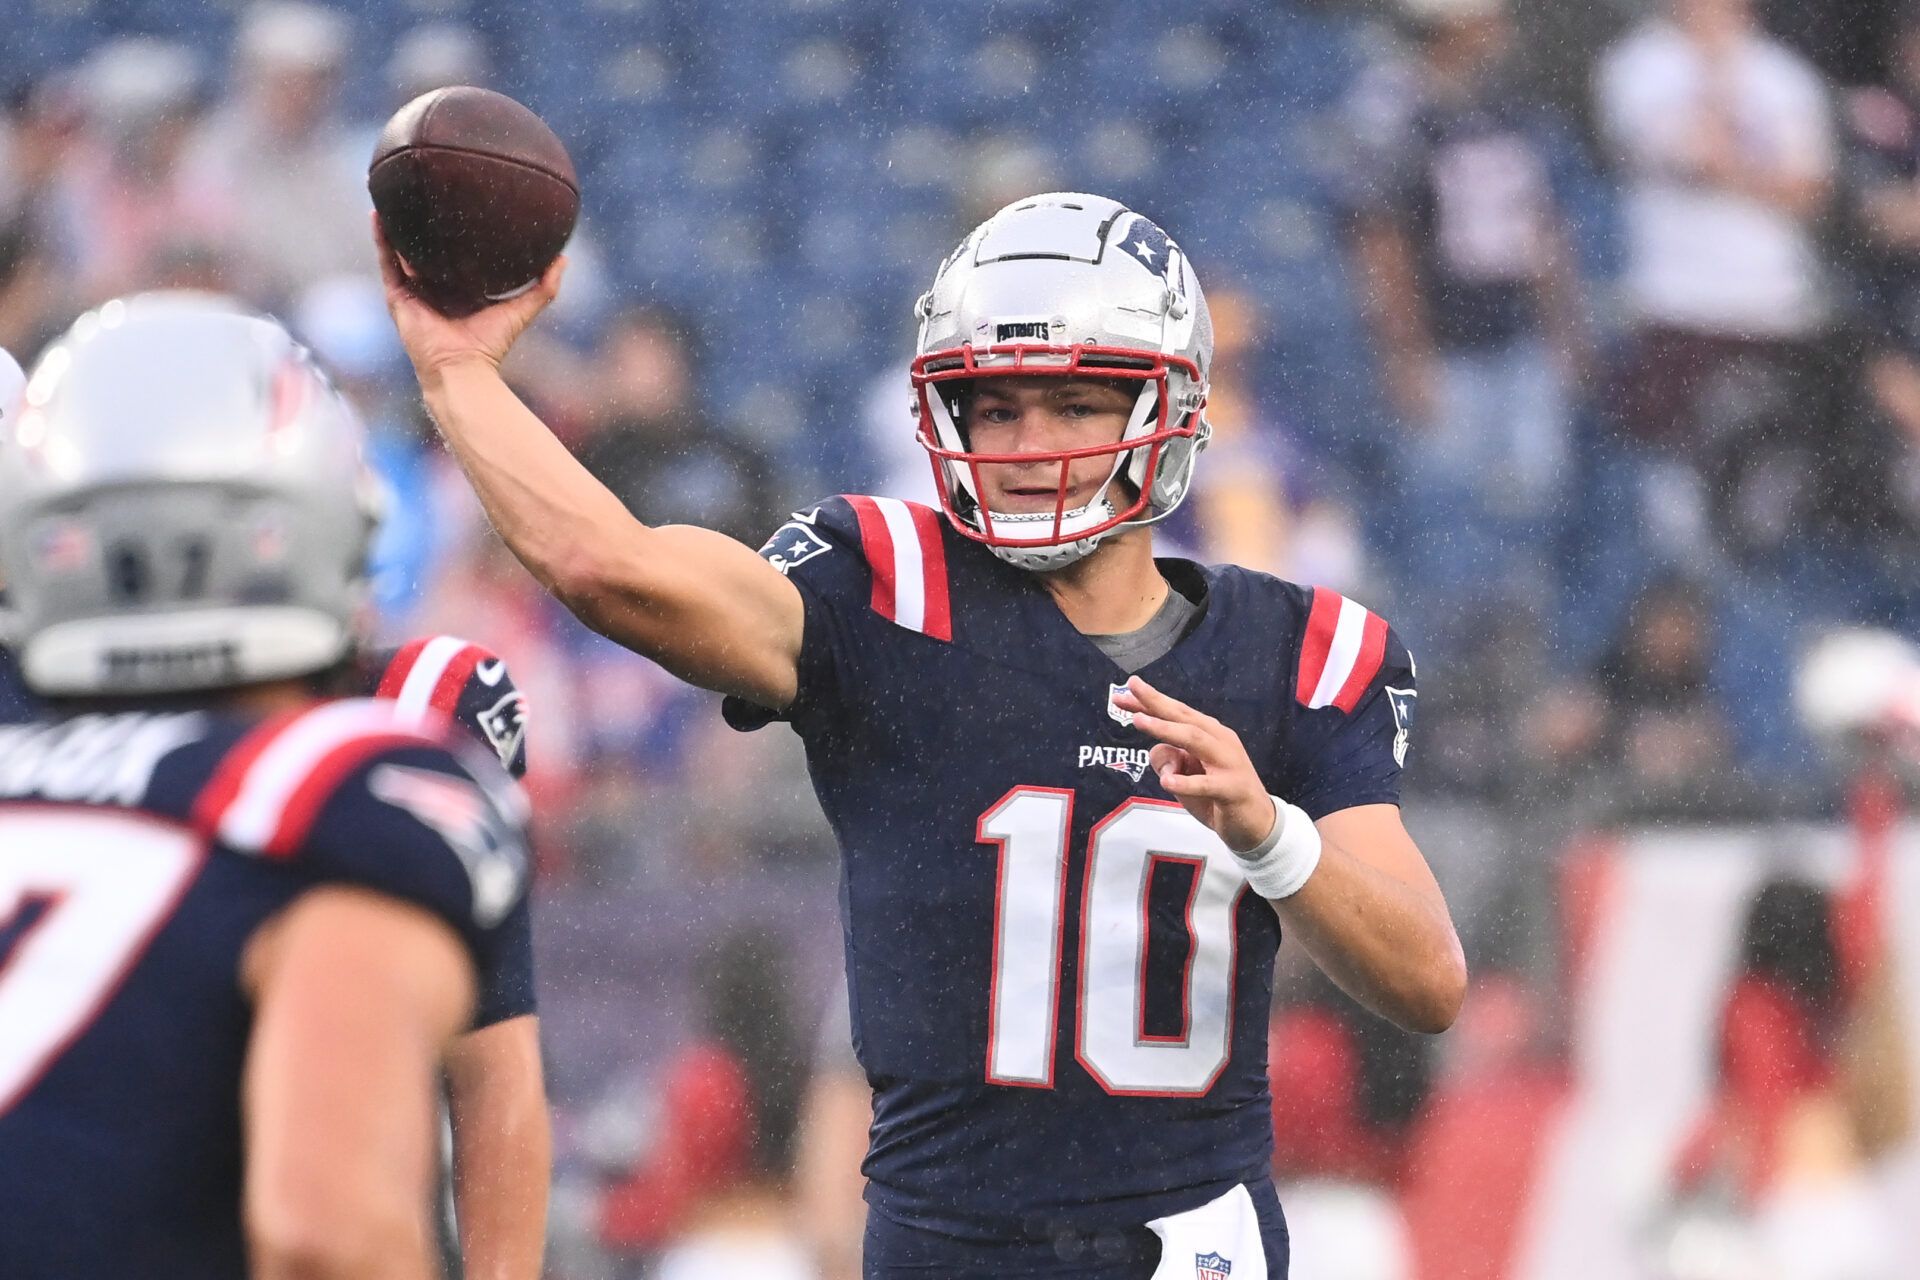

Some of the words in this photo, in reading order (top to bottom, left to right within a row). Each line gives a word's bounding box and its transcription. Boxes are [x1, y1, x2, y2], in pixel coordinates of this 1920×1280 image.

[996, 322, 1049, 343] PATRIOTS
[1078, 745, 1150, 768] PATRIO
[975, 784, 1248, 1098] 10
